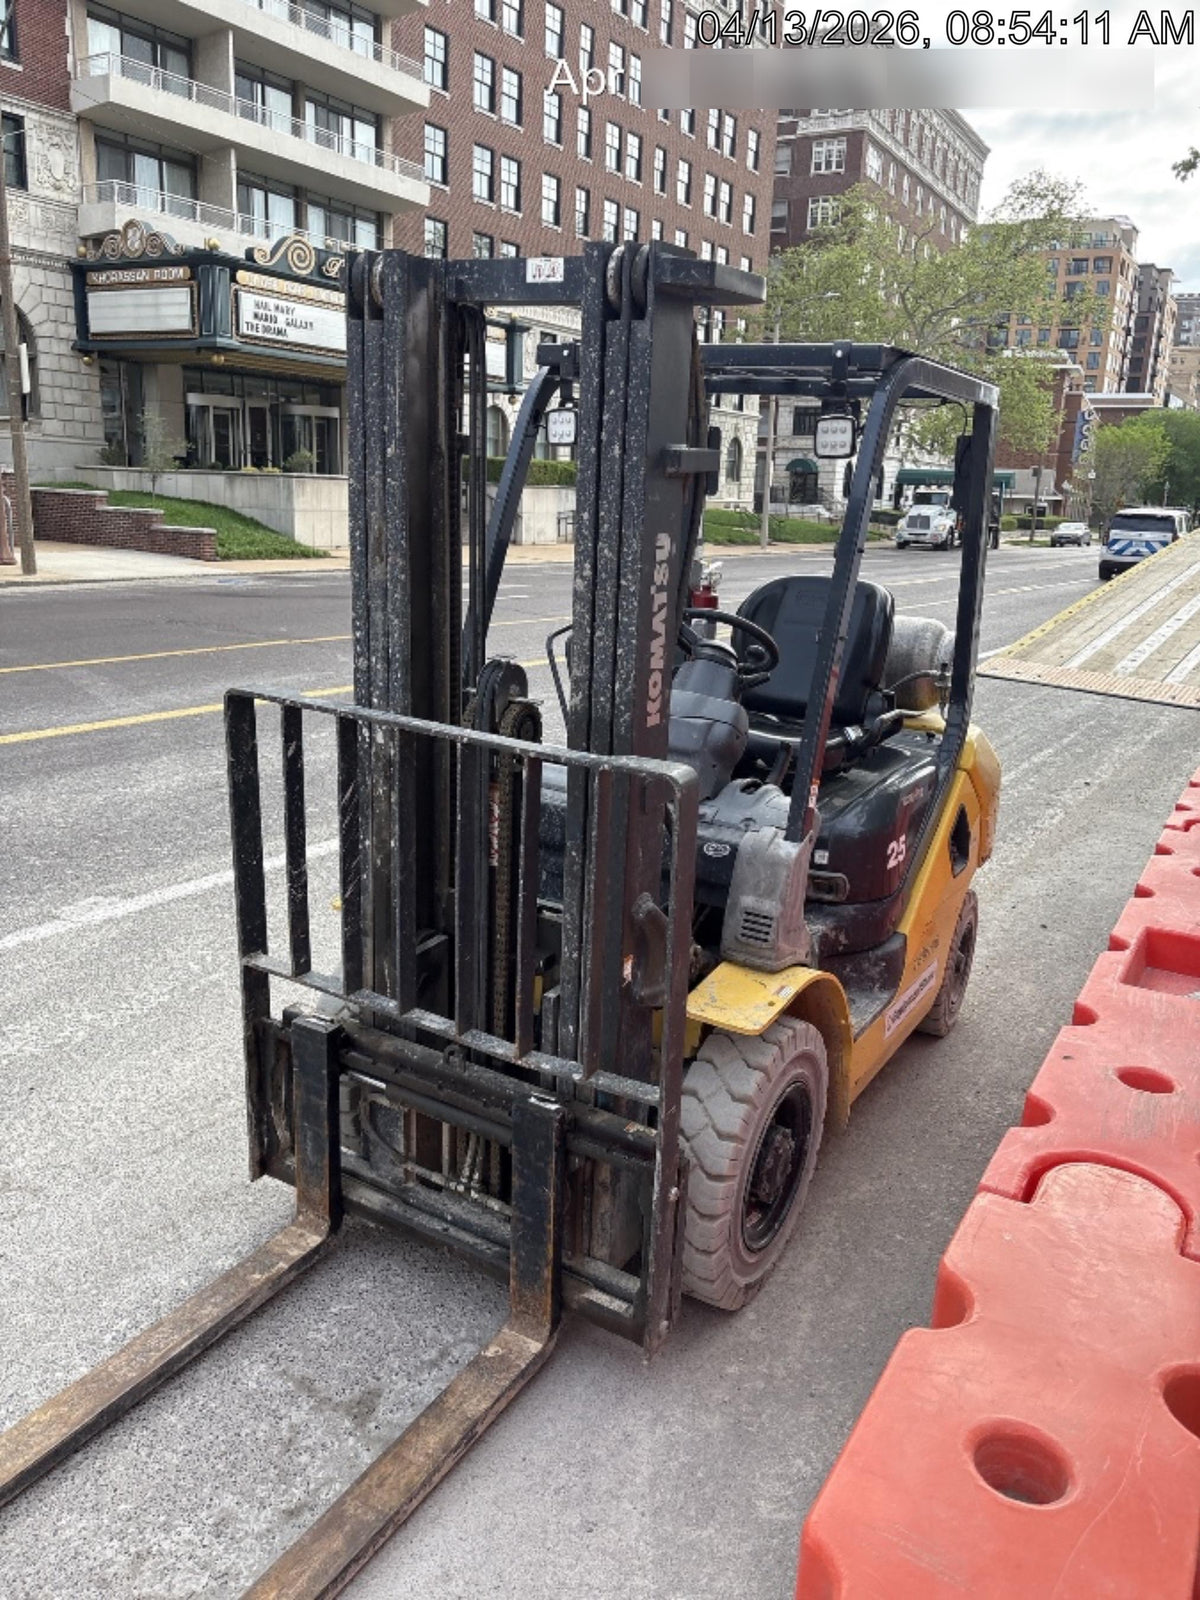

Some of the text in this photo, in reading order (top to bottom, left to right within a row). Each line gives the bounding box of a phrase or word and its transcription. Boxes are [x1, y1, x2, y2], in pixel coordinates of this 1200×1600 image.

[91, 267, 184, 284] KHORASSAN ROOM
[254, 299, 296, 316] HAIL MARY
[253, 311, 278, 325] MARIO
[245, 321, 288, 338] THE DRAMA
[646, 532, 672, 728] KOMATSU
[886, 834, 907, 871] 25
